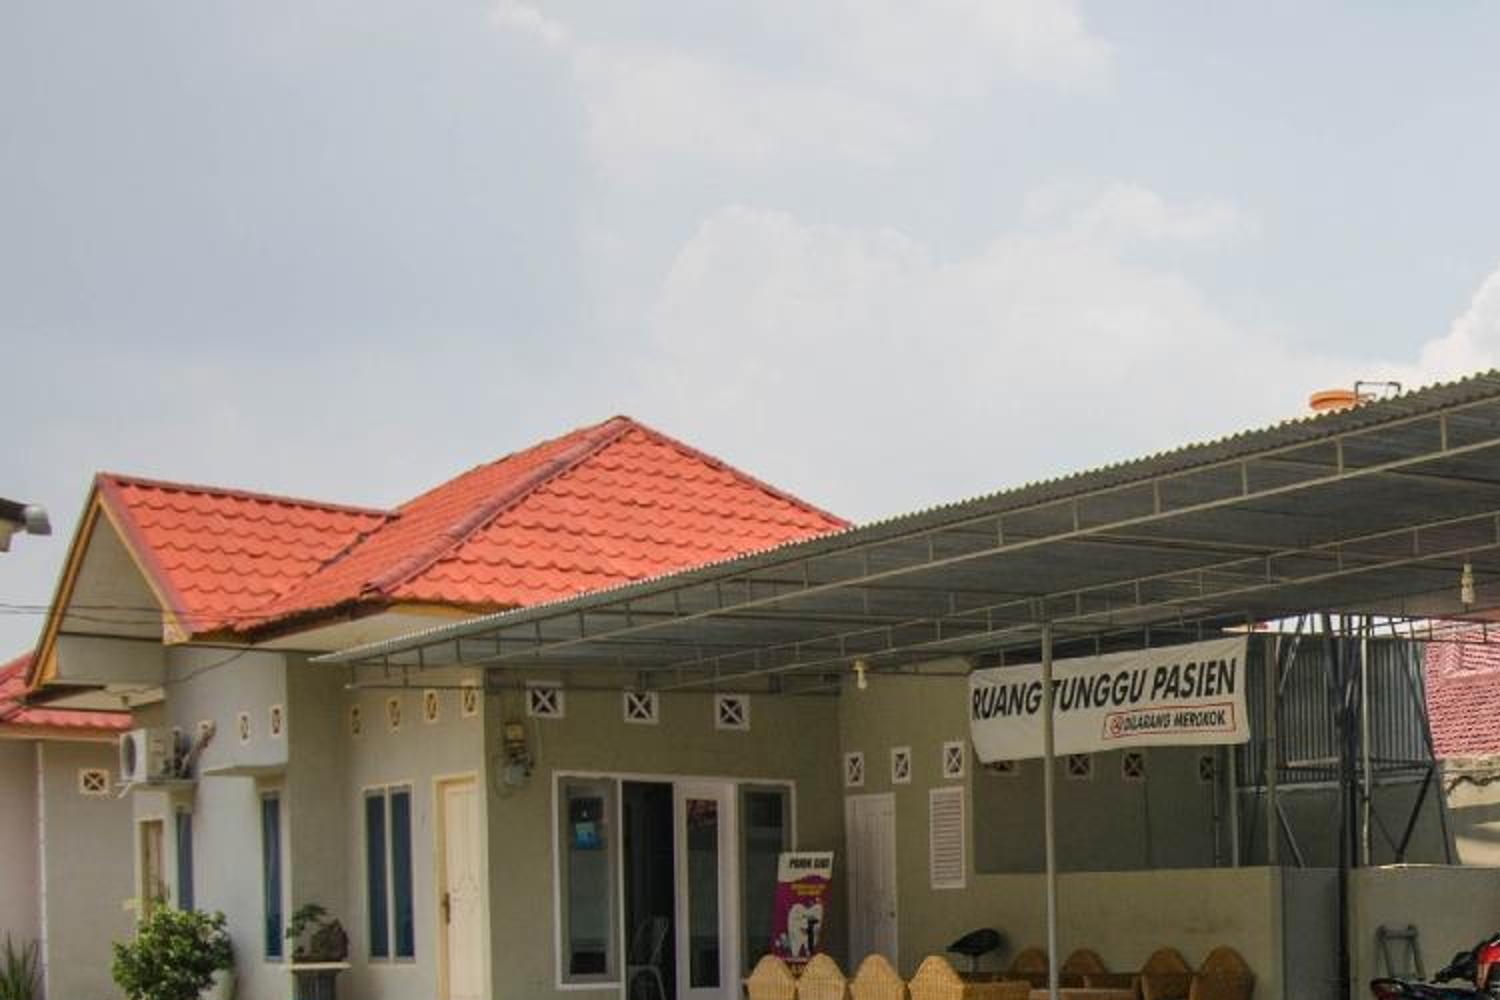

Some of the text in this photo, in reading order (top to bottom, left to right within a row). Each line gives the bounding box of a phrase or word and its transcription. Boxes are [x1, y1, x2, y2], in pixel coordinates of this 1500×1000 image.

[971, 657, 1237, 721] RUANG TUNGGU PASIEN
[1173, 708, 1225, 728] MEROKOK
